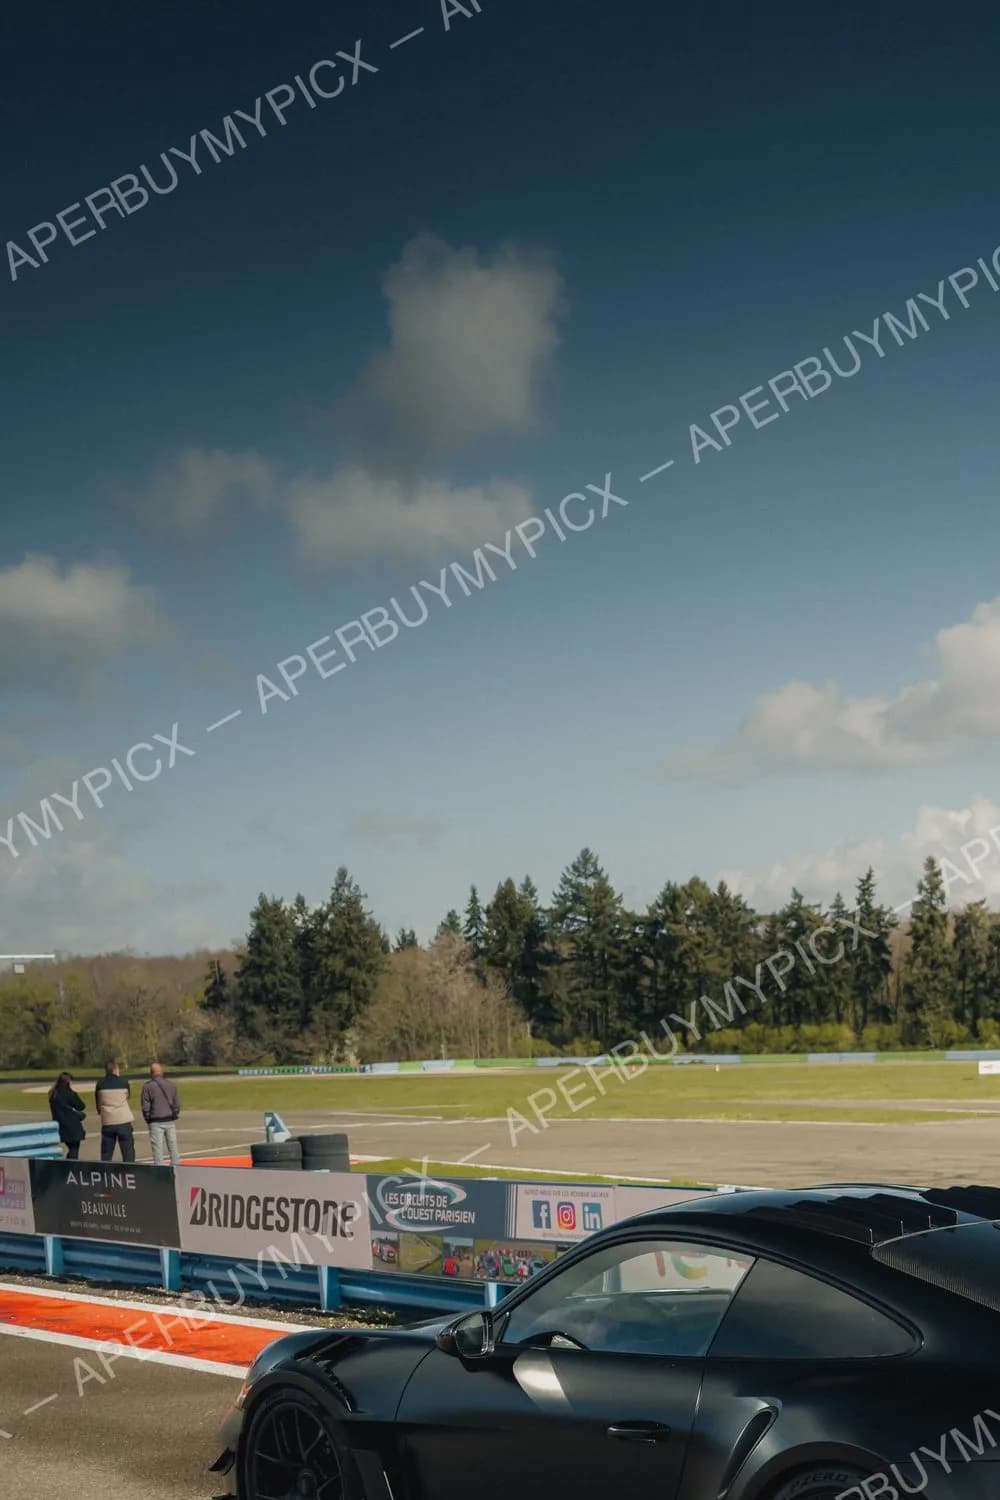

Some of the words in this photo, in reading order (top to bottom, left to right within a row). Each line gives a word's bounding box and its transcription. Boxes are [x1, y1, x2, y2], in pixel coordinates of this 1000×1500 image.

[66, 1171, 136, 1189] ALPINE
[82, 1201, 127, 1218] DEAUVILLE
[436, 1195, 447, 1208] DE
[190, 1187, 355, 1238] BRIDGESTONE
[435, 1210, 475, 1224] PARISIEN
